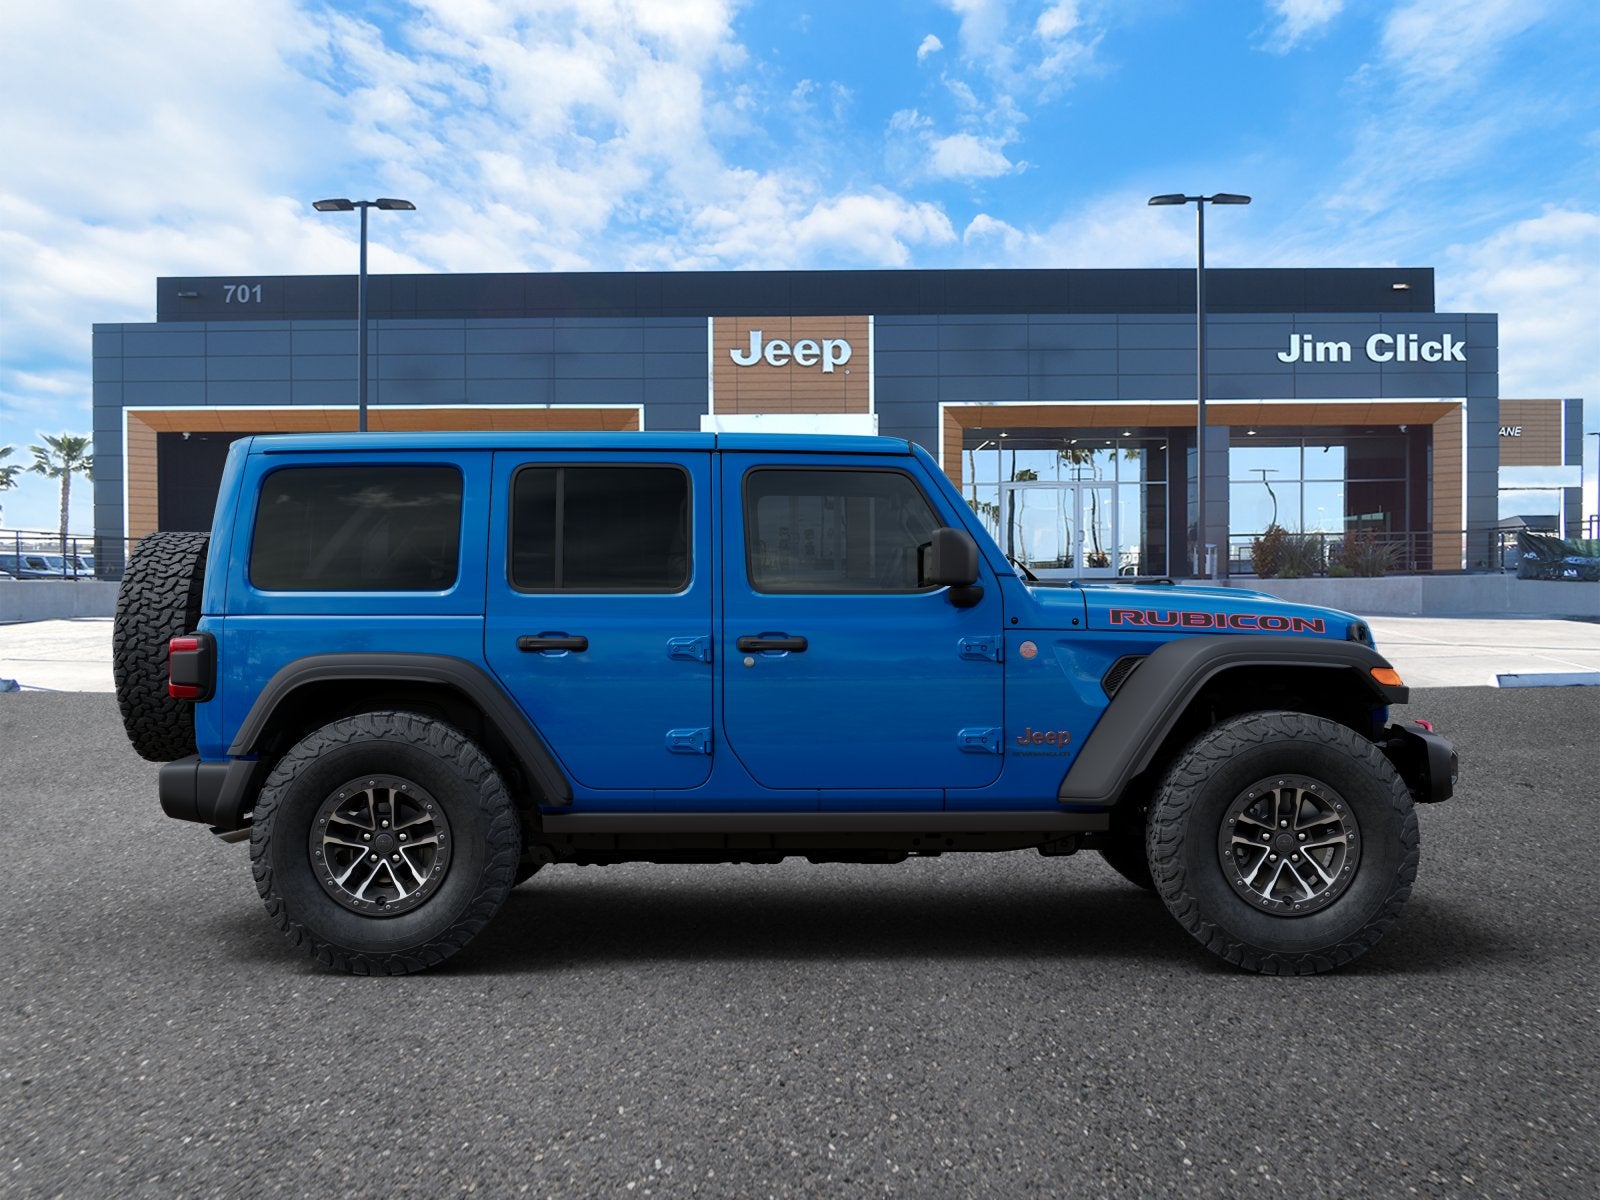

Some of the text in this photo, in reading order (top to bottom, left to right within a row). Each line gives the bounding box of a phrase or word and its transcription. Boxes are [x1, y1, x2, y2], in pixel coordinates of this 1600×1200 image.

[223, 284, 262, 303] 701
[730, 330, 852, 373] Jeep
[1277, 333, 1467, 363] Jim Click
[1109, 608, 1326, 633] RUBICON
[1017, 727, 1071, 748] Jeep
